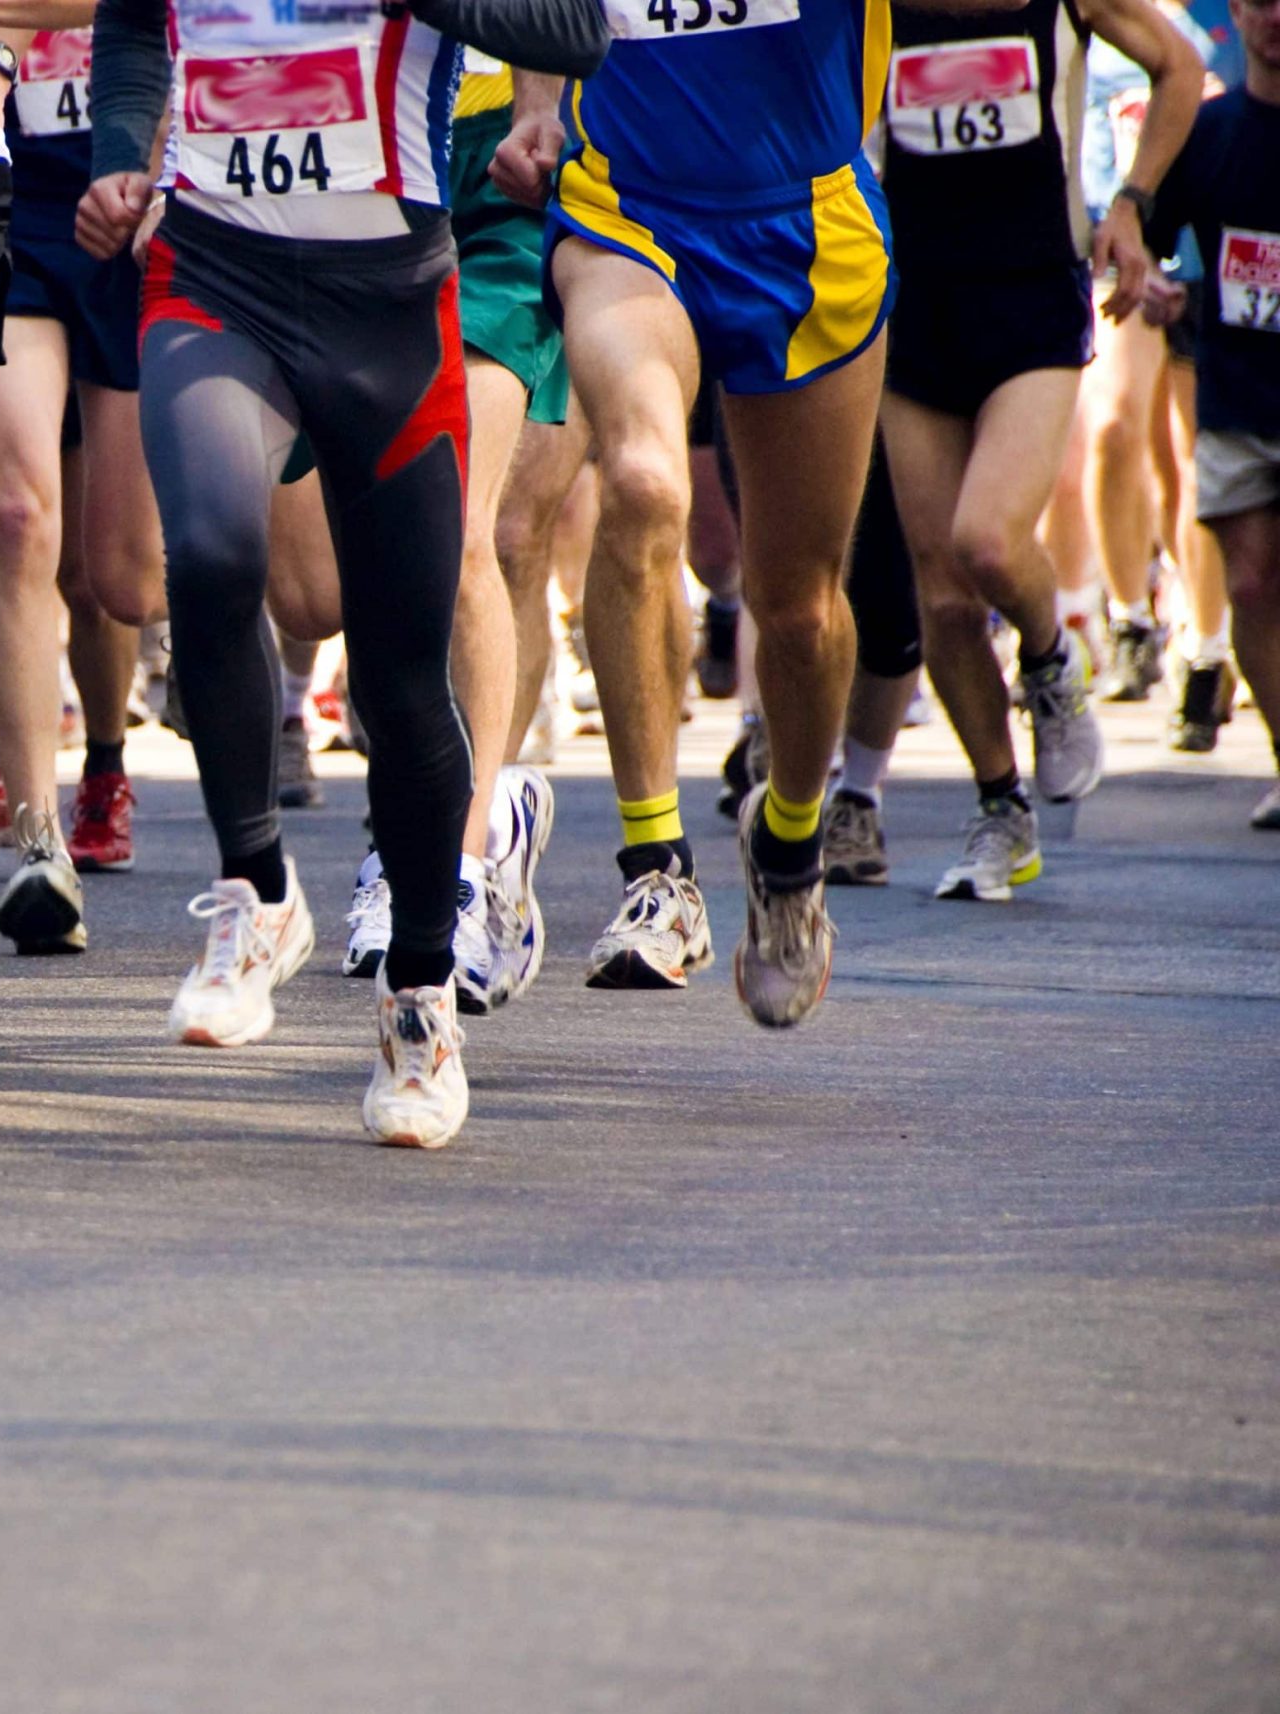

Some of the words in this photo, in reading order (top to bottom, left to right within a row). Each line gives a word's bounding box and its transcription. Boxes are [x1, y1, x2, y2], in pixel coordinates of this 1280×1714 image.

[57, 81, 93, 128] 4
[933, 102, 1004, 149] 163
[226, 132, 331, 197] 464
